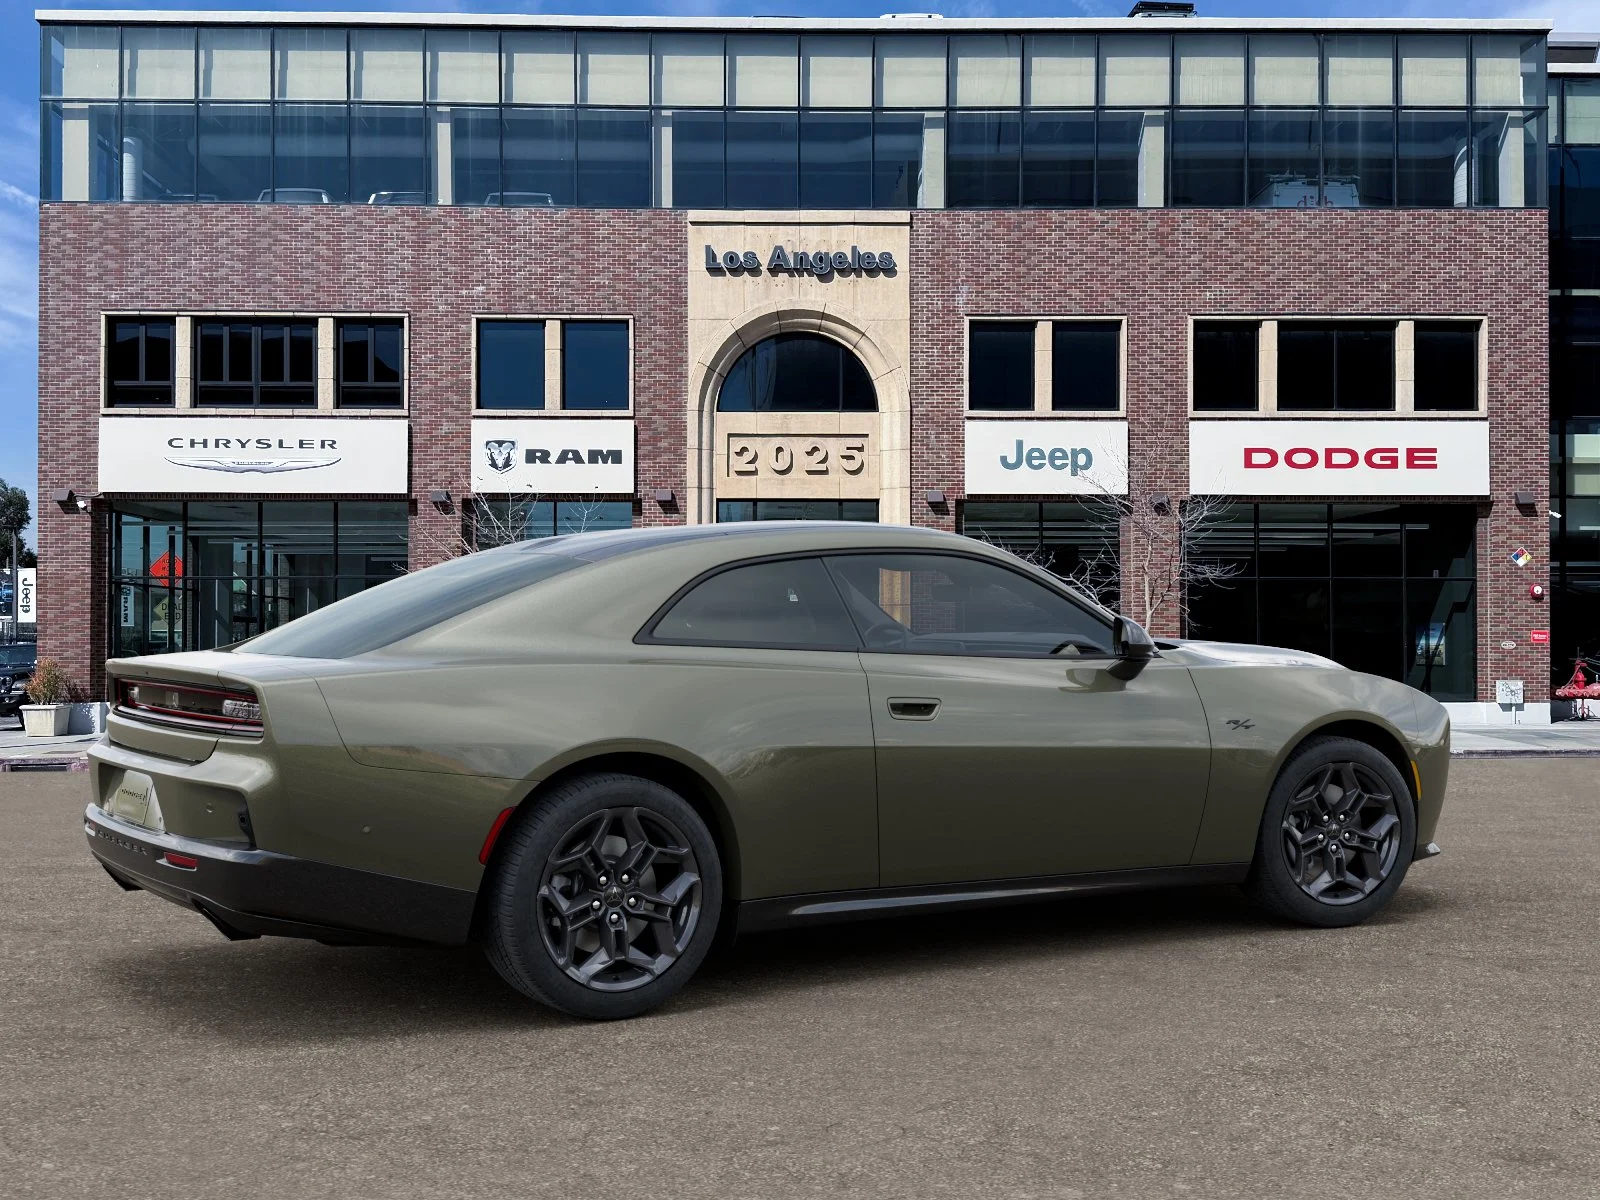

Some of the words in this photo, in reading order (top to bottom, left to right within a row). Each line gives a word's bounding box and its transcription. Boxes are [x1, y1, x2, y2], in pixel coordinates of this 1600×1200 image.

[705, 244, 758, 269] Los
[767, 245, 894, 275] Angeles
[167, 437, 338, 450] CHRYSLER
[525, 448, 623, 464] RAM
[733, 441, 865, 474] 2025
[999, 439, 1093, 476] Jeep
[1243, 447, 1438, 470] DODGE
[20, 577, 34, 614] Jeep
[164, 612, 181, 620] ED
